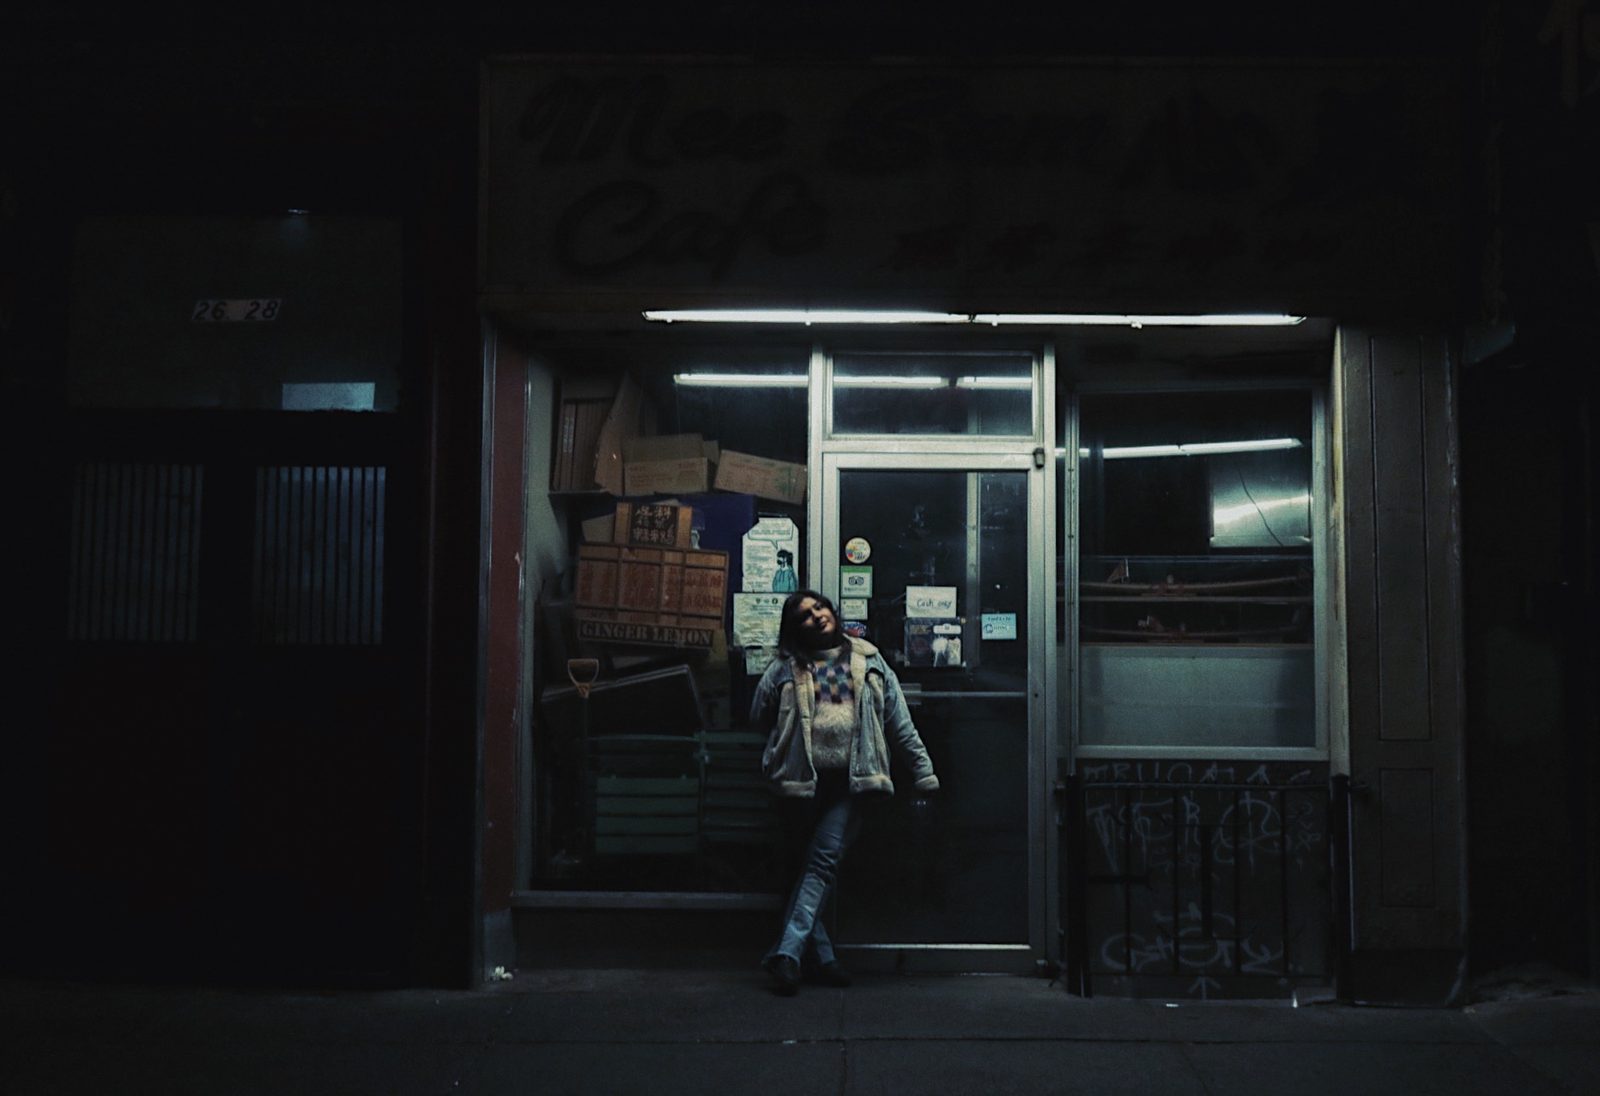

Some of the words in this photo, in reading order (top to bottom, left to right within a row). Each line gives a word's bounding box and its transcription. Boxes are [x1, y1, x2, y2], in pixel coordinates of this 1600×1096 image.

[519, 74, 790, 168] Mee
[245, 301, 278, 319] 28
[581, 622, 649, 641] GINGER
[653, 629, 713, 647] LEMON
